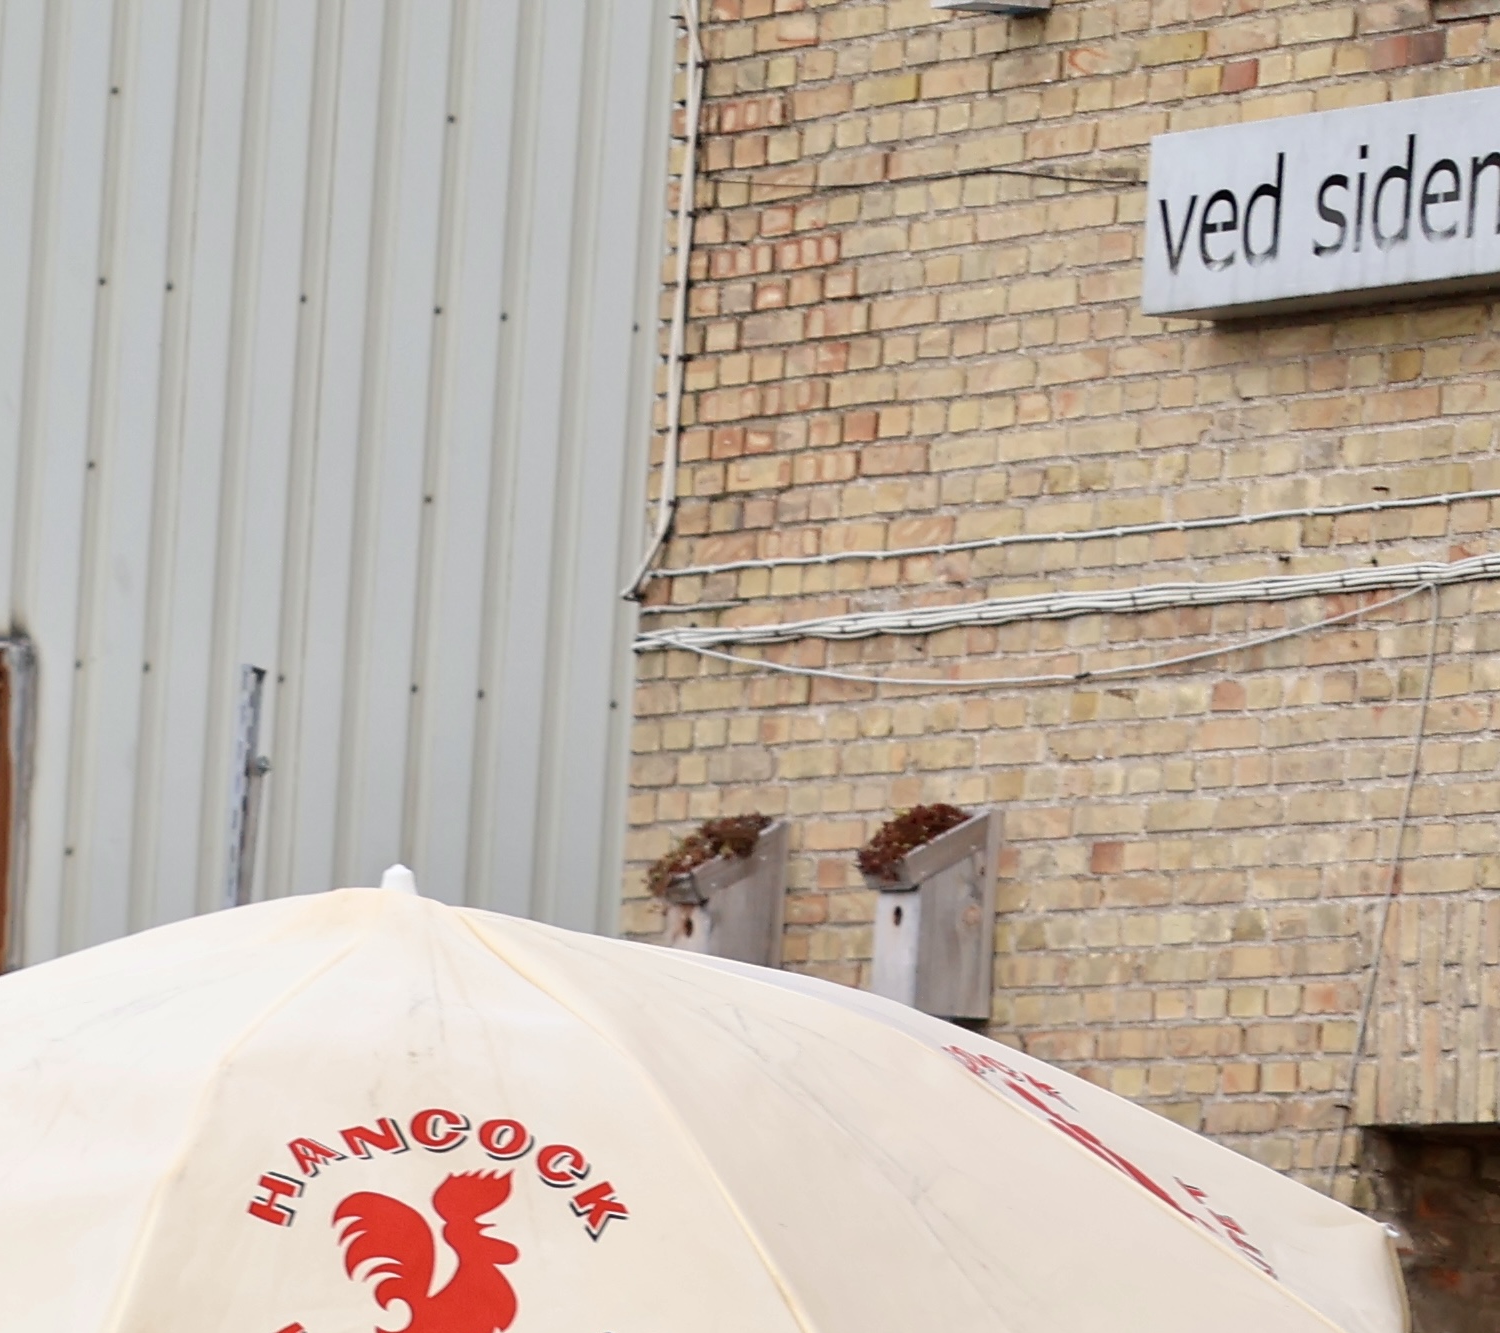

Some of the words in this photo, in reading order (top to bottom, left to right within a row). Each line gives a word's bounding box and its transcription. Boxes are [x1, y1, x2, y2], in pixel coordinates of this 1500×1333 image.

[1158, 152, 1287, 276] ved
[1312, 134, 1500, 258] siden
[246, 1108, 630, 1241] HANCOCK
